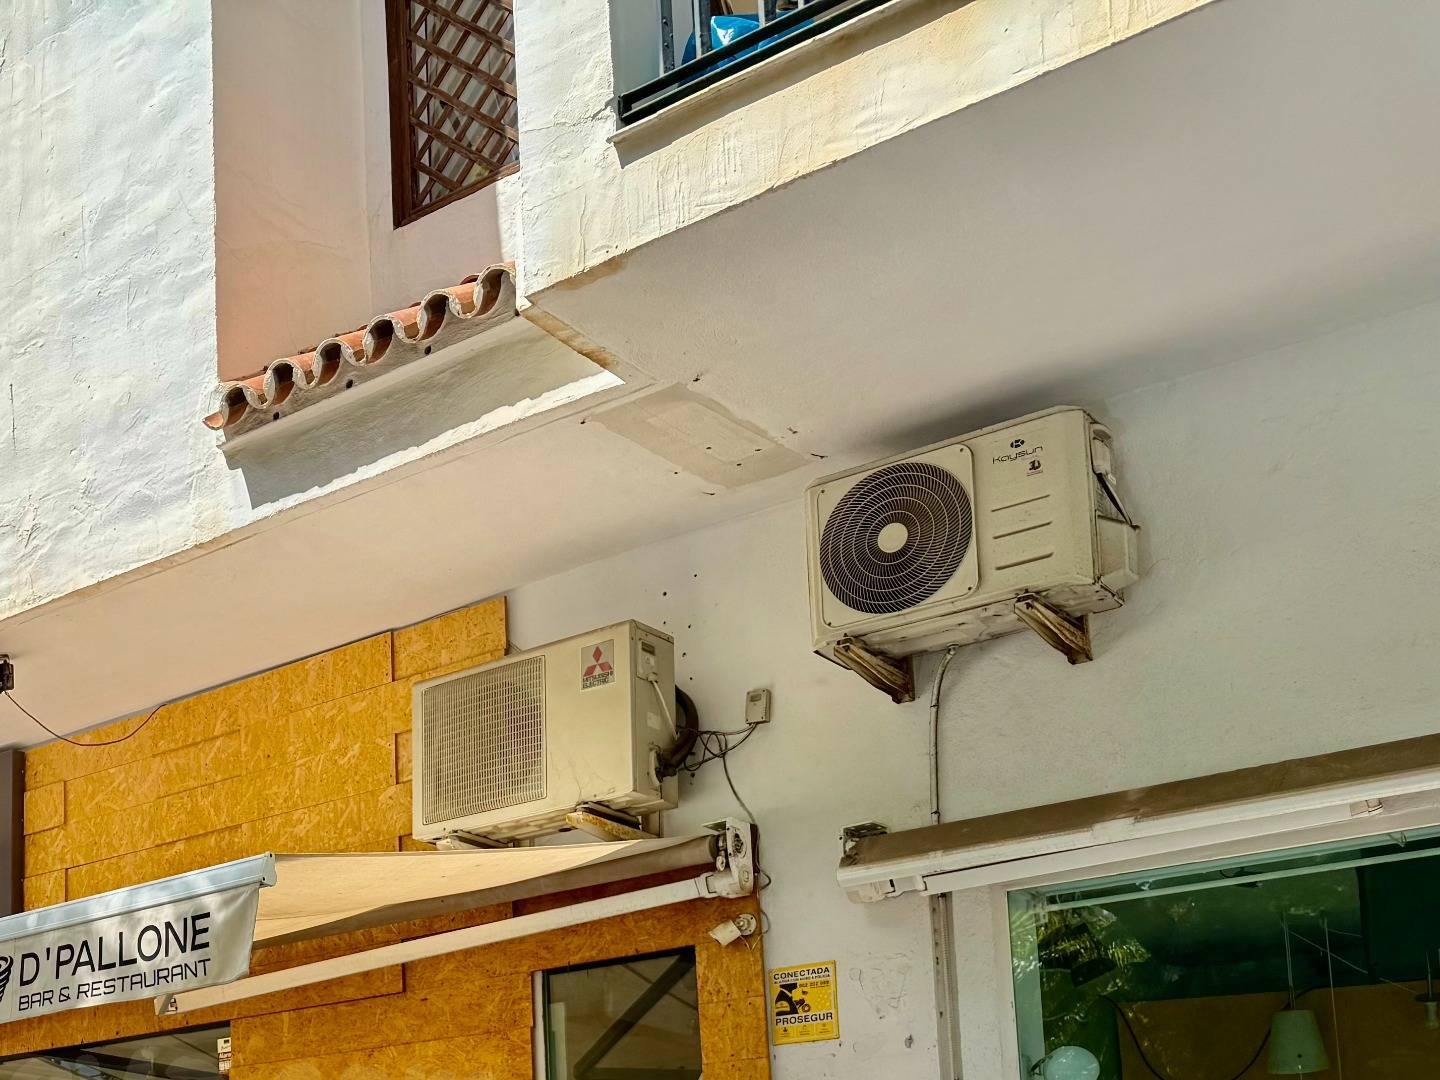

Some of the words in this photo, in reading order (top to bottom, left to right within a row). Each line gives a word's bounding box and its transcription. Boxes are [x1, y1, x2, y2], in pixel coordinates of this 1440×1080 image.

[773, 966, 830, 981] CONECTADA
[18, 990, 54, 1011] BAR
[58, 986, 71, 1004] &
[76, 958, 212, 1000] RESTAURANT
[775, 1012, 833, 1026] PROSEGUR
